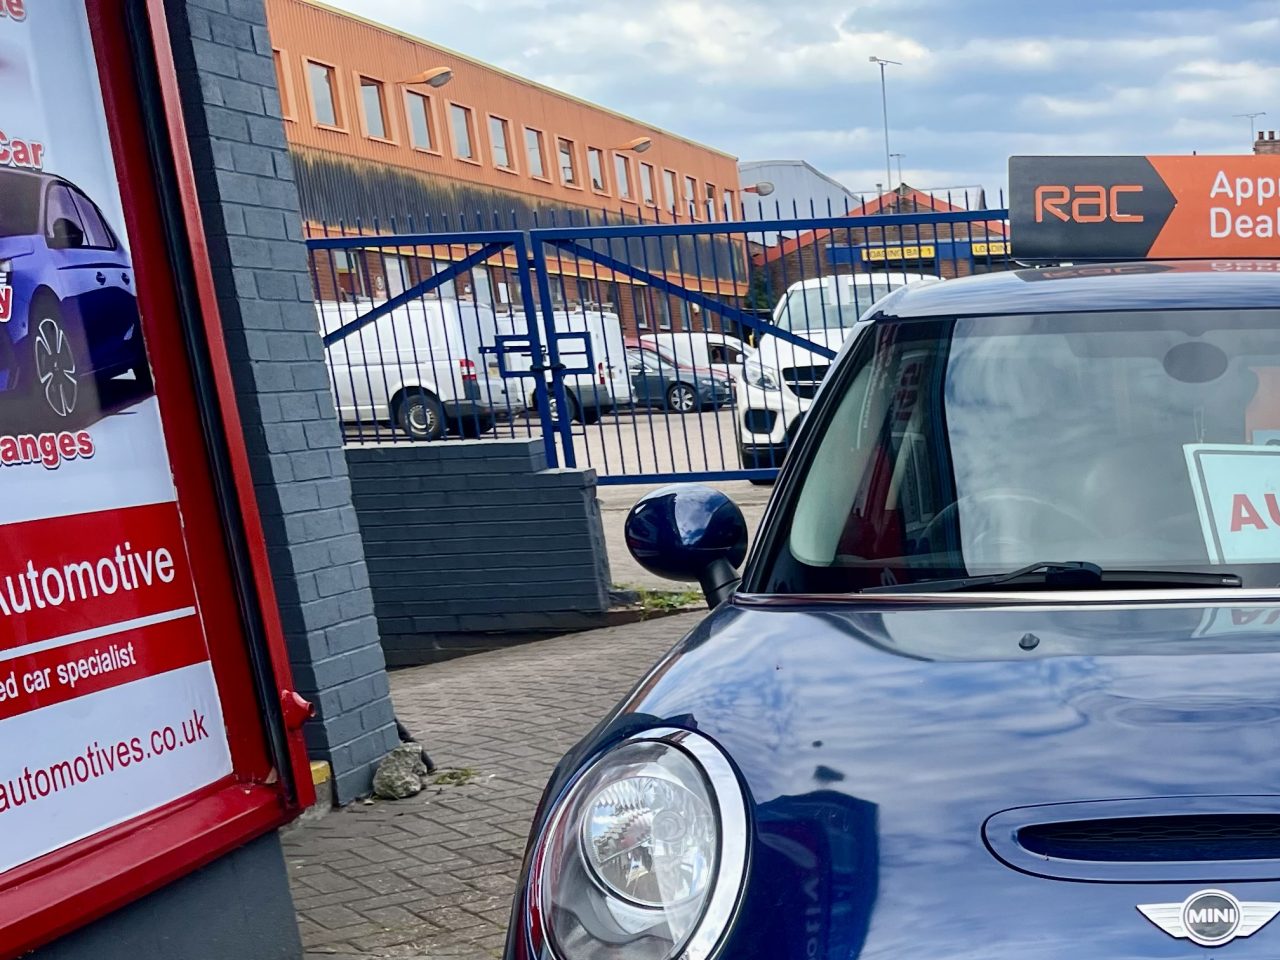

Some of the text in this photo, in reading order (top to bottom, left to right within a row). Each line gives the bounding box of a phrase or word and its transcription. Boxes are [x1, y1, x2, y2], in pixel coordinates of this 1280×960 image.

[0, 430, 93, 468] anges
[23, 668, 51, 694] car
[57, 641, 137, 688] specialist
[1189, 908, 1235, 924] MINI
